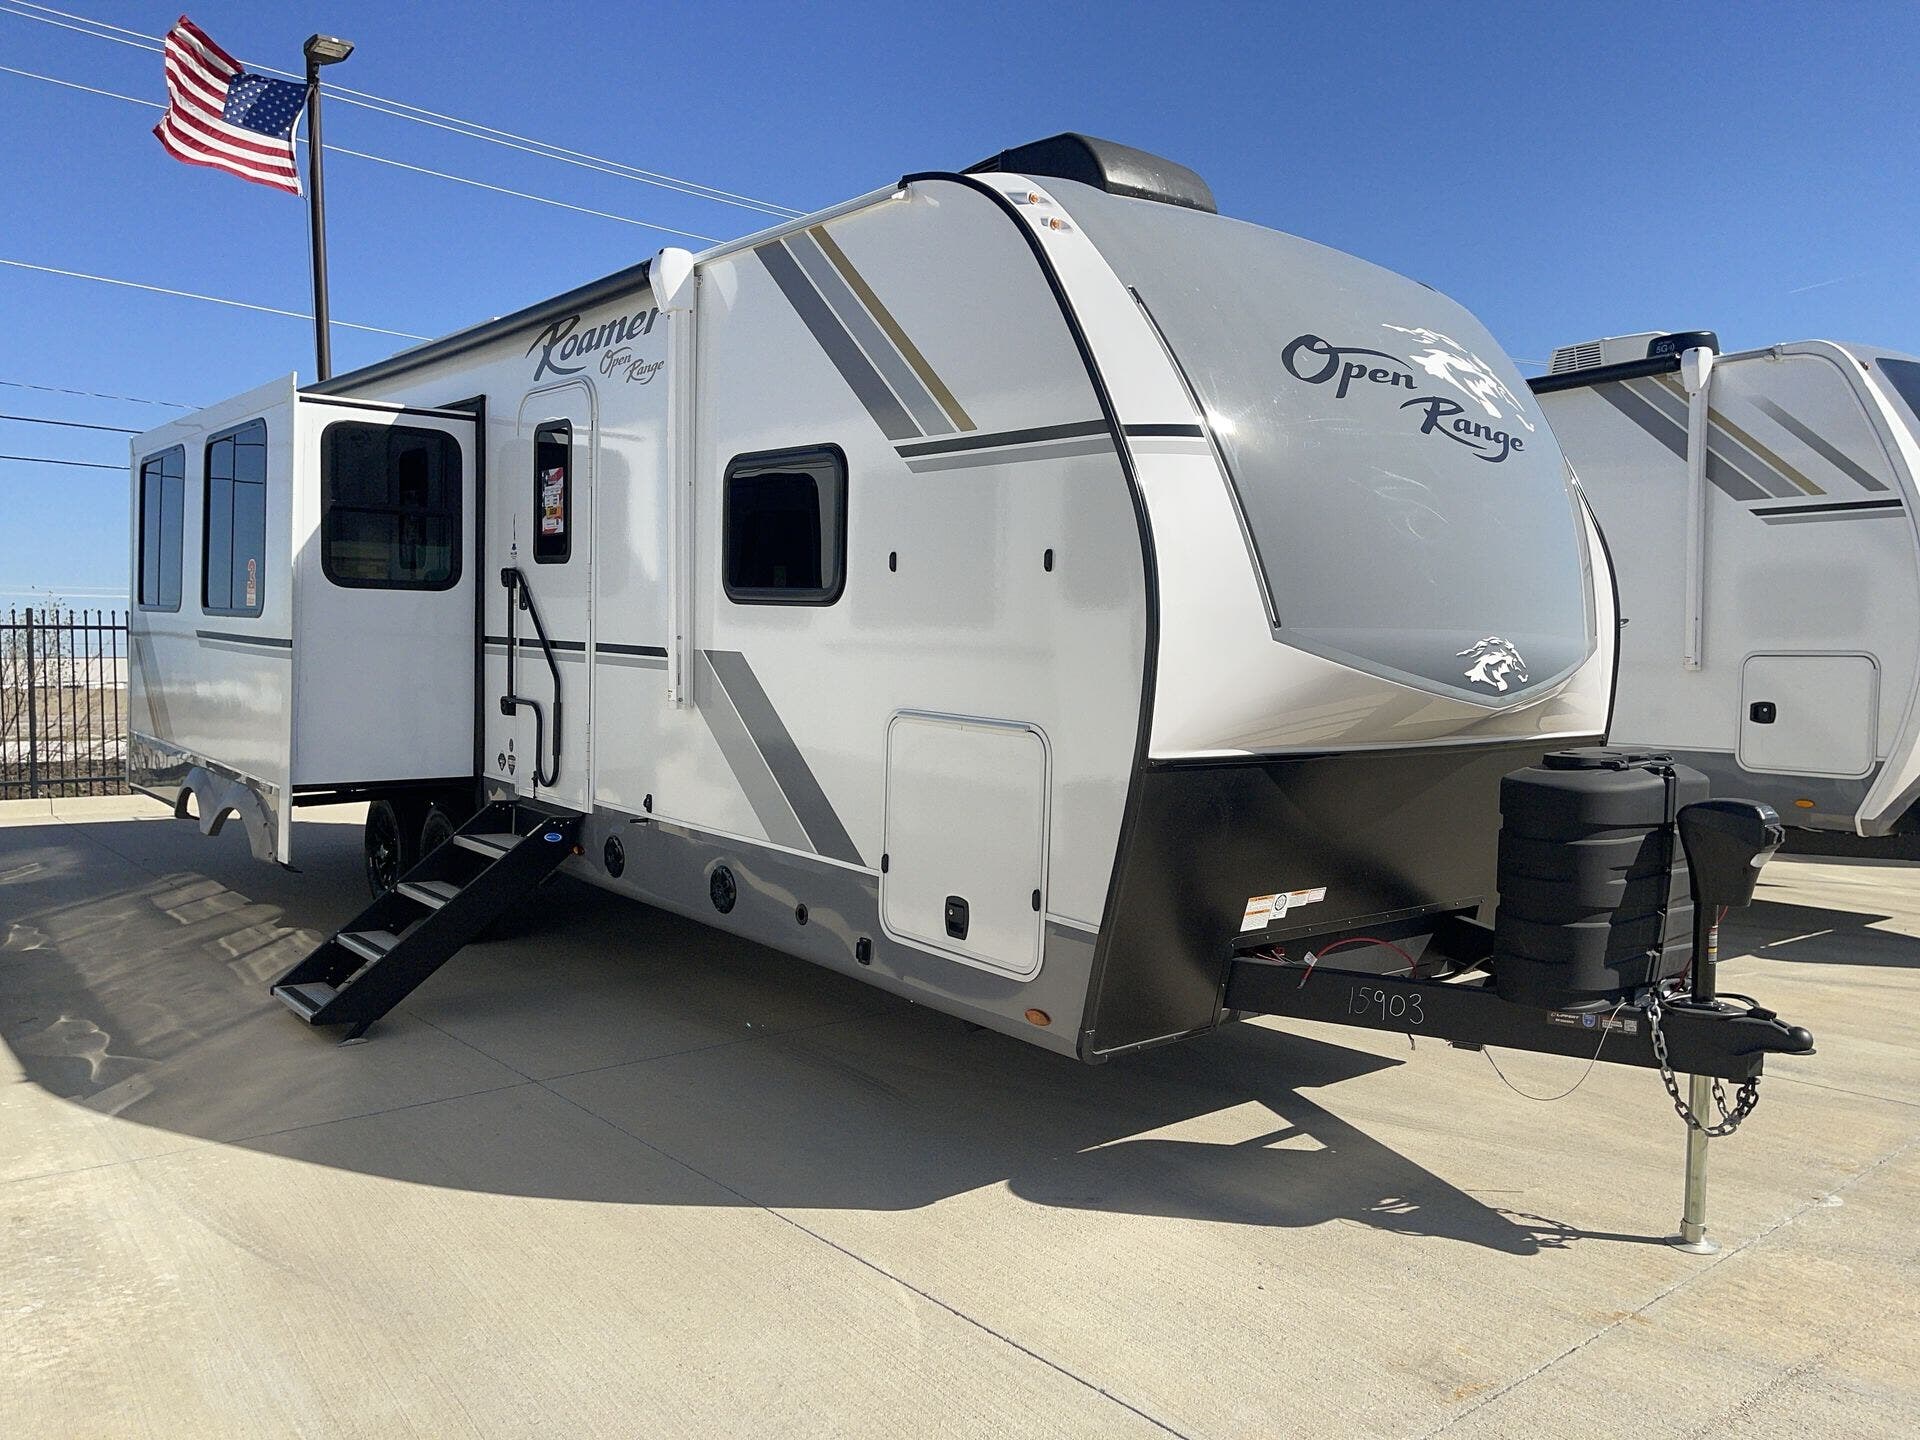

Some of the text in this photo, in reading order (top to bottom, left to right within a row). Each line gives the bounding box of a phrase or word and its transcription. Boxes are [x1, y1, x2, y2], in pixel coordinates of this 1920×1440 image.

[526, 307, 662, 381] Roamer
[600, 347, 632, 378] Open
[1282, 333, 1418, 398] Open
[623, 359, 665, 385] Range
[1399, 396, 1525, 463] Range
[1348, 986, 1424, 1025] 15903
